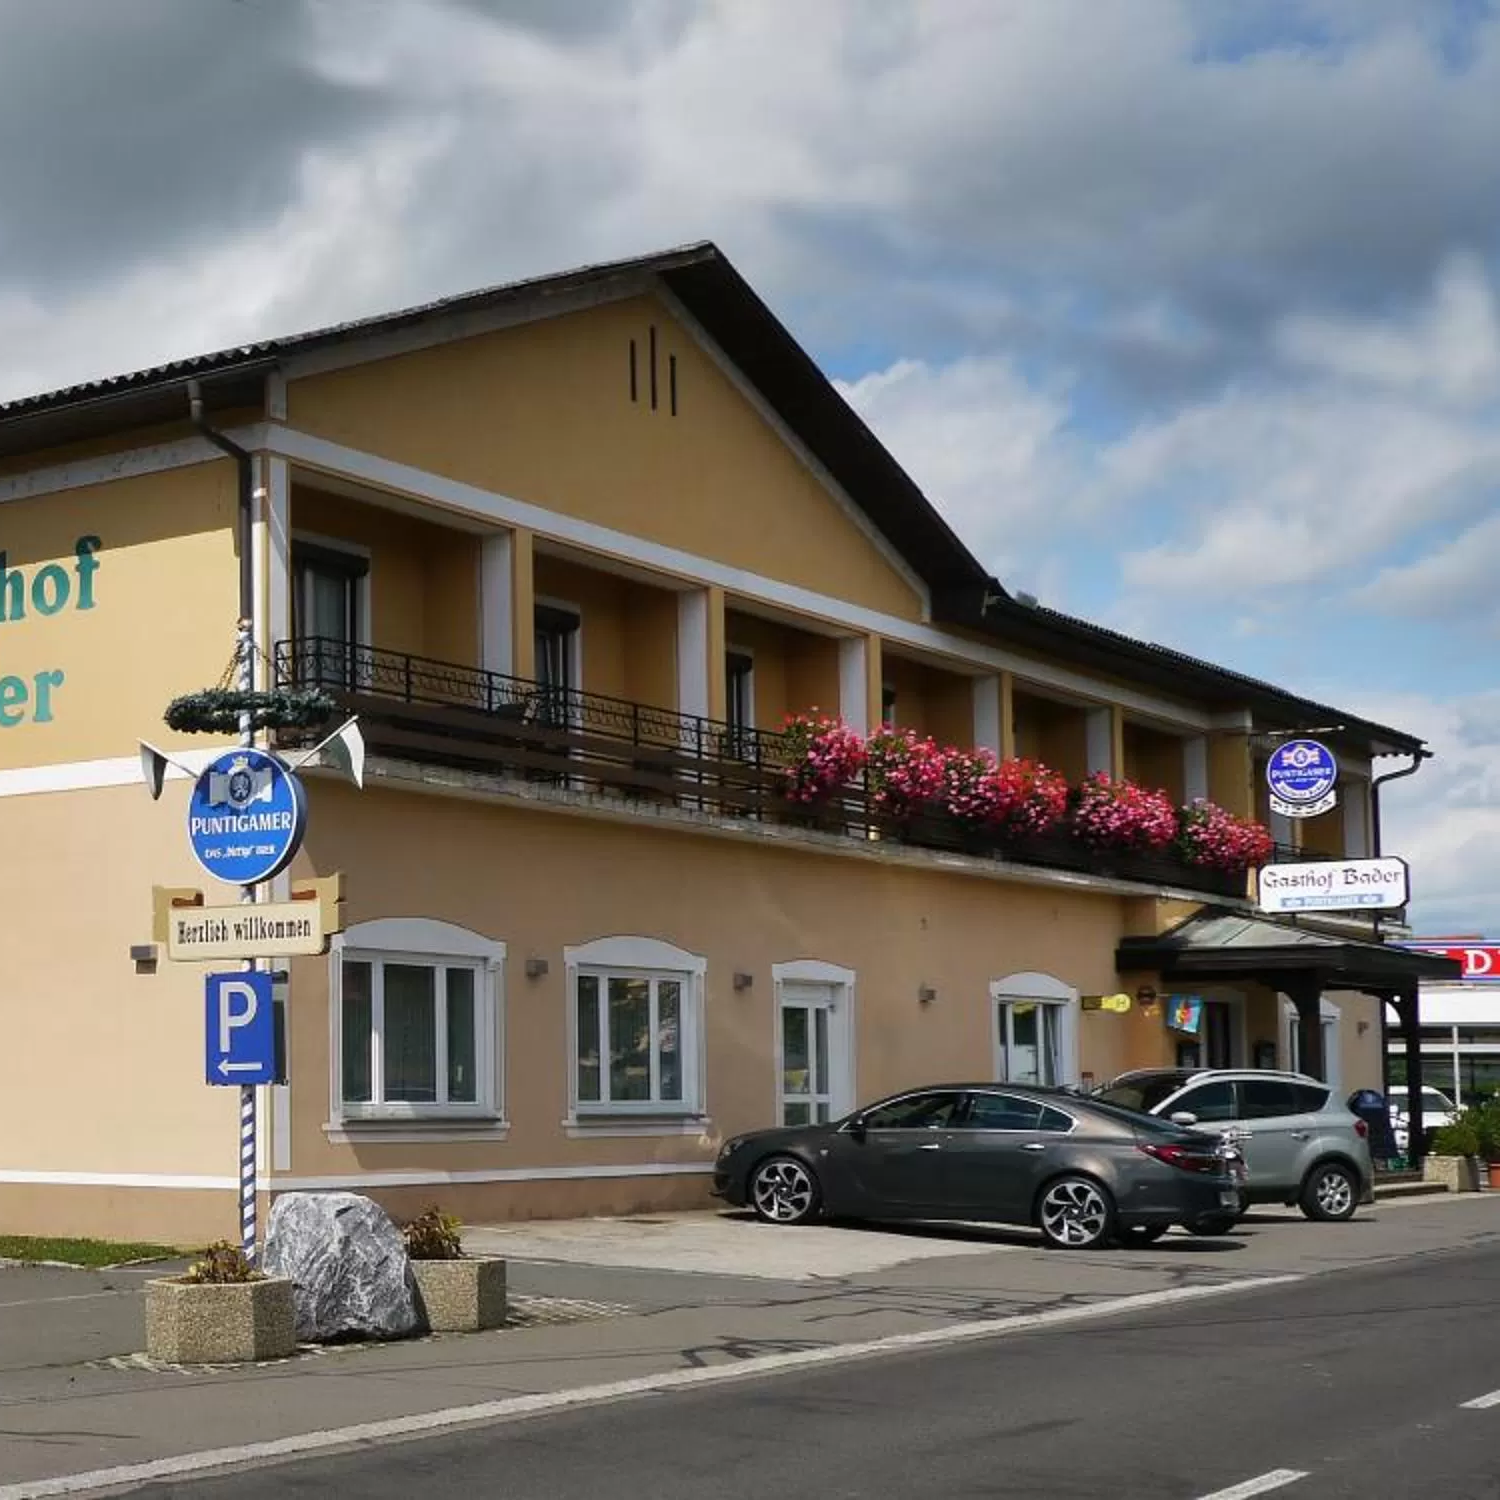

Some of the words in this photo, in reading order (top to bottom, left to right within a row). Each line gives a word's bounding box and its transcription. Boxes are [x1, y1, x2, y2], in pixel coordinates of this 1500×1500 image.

[191, 811, 292, 837] PUNTIGAMER
[1263, 869, 1333, 894] Gasthof
[1342, 867, 1402, 885] Bader
[177, 919, 229, 945] Herzlich
[233, 916, 312, 941] willkommen
[219, 981, 258, 1053] P
